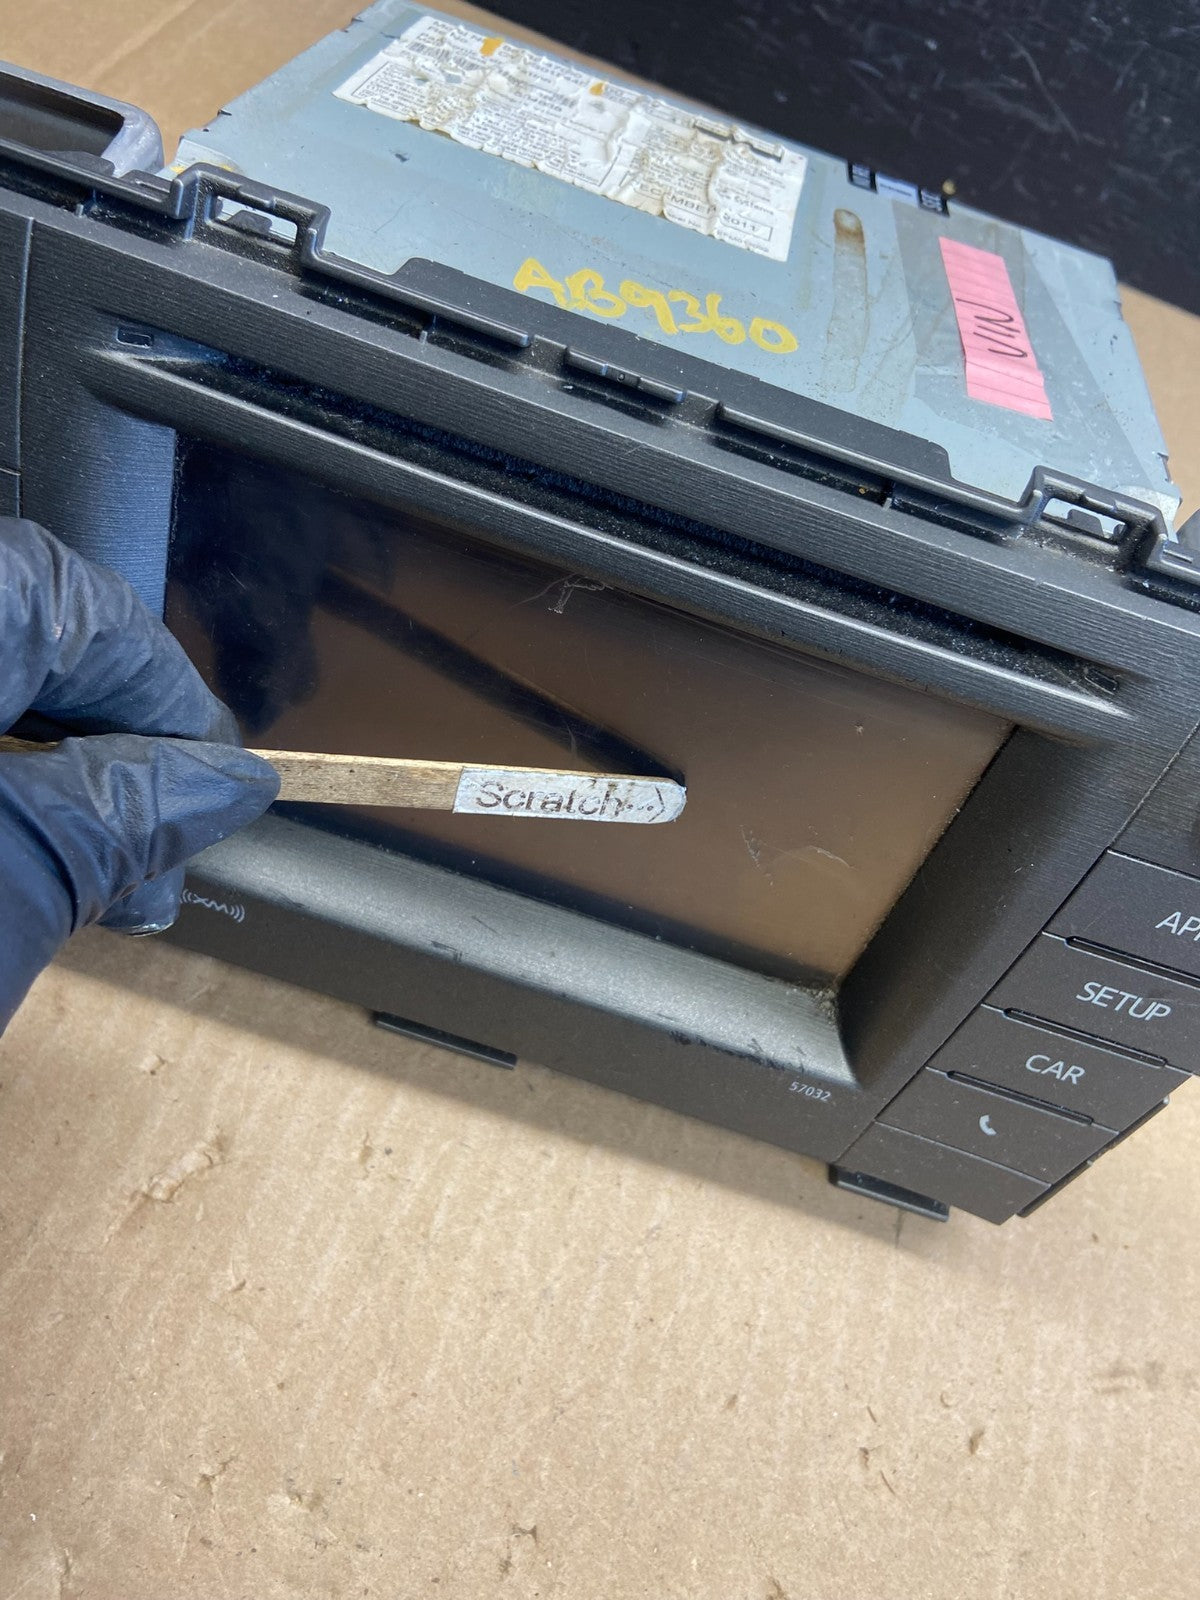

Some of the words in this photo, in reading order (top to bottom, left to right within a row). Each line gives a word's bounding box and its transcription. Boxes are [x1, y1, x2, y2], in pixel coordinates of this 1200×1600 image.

[513, 257, 798, 354] AB9360
[955, 297, 1028, 358] VIN
[1154, 911, 1200, 941] AP
[1076, 981, 1171, 1022] SETUP
[1025, 1054, 1086, 1085] CAR
[788, 1080, 832, 1103] 57032
